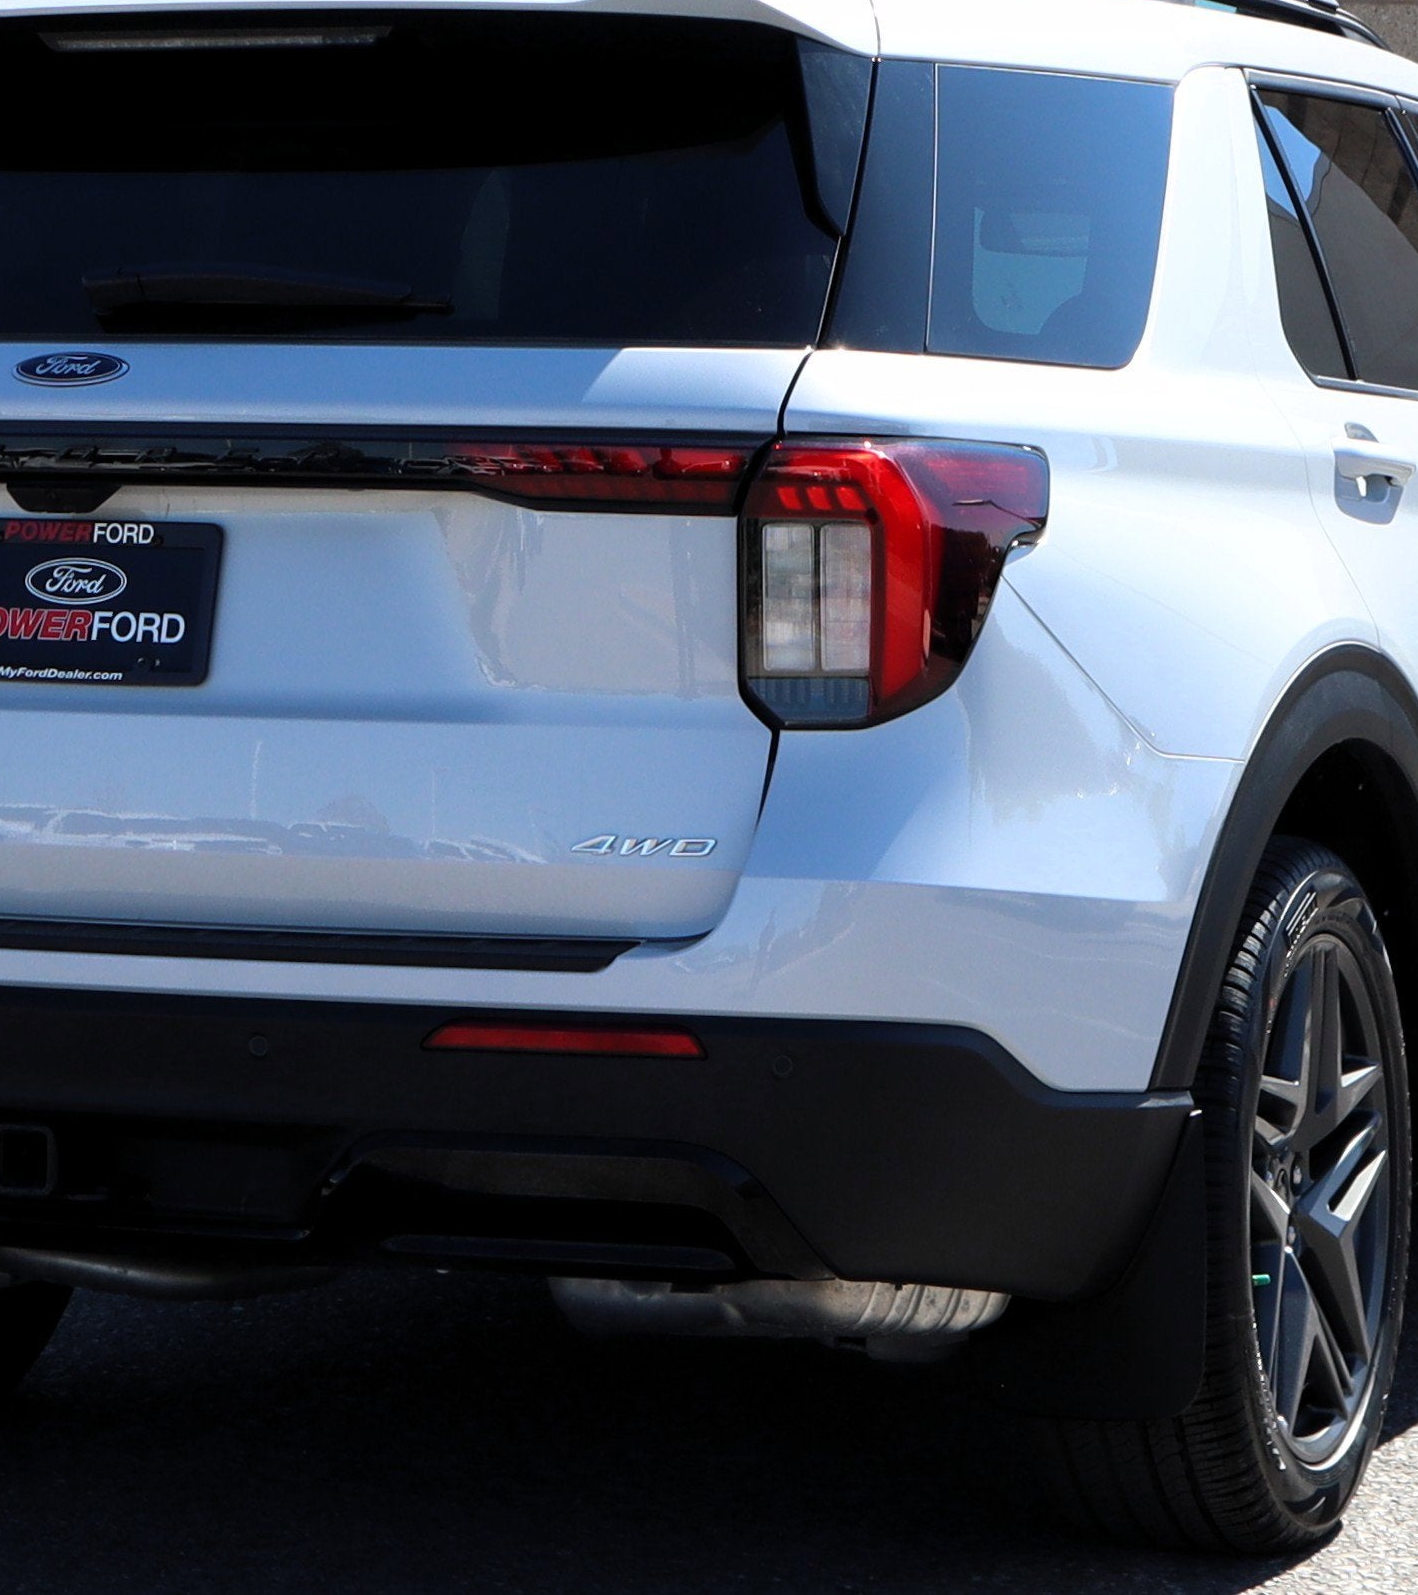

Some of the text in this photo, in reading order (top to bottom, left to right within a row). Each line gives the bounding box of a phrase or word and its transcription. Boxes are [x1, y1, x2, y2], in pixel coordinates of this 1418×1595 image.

[35, 355, 102, 375] Ford
[3, 520, 154, 545] POWERFORD
[45, 566, 107, 594] Ford
[571, 834, 718, 857] 4WD
